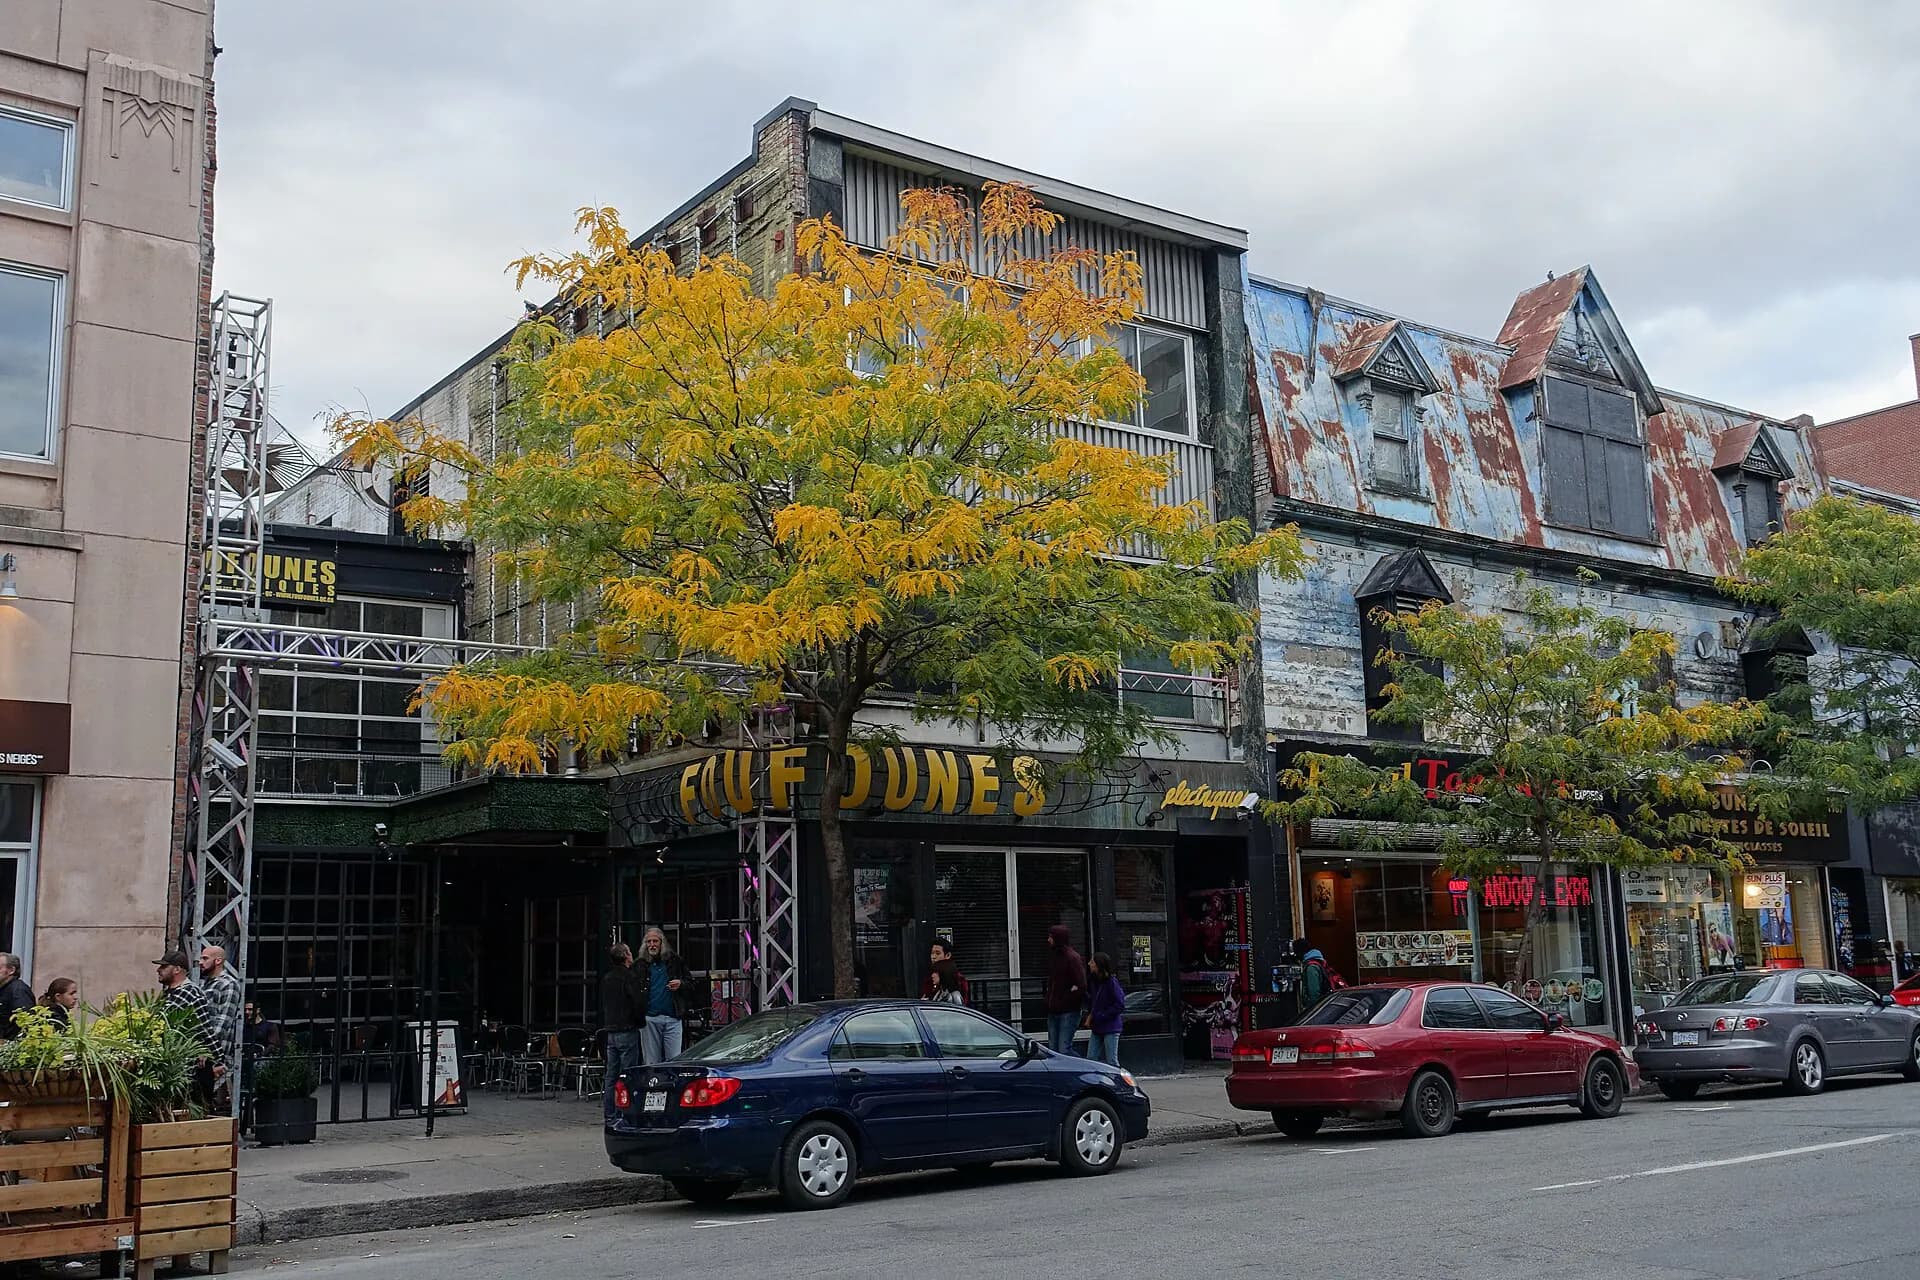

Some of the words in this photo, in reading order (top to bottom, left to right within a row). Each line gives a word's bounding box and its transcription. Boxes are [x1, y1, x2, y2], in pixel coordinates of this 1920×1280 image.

[1753, 819, 1775, 837] DE
[1778, 821, 1831, 839] SOLEIL
[1746, 874, 1762, 884] SUN
[1764, 872, 1783, 883] PLUS
